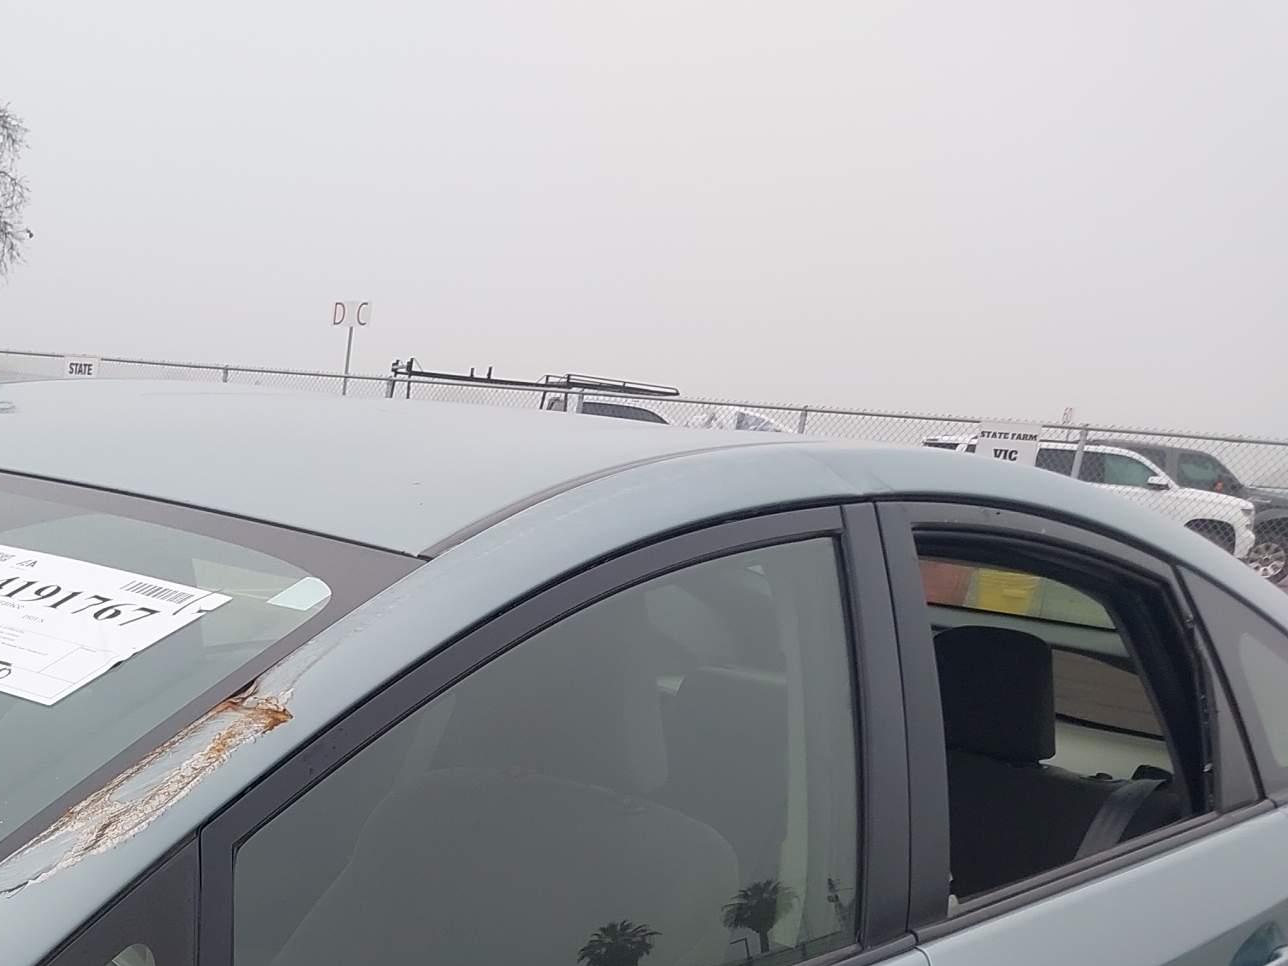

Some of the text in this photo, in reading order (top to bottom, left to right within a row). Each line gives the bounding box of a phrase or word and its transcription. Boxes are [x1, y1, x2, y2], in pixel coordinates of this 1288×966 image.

[333, 302, 369, 326] D C
[68, 362, 93, 376] STATE
[980, 430, 1038, 441] STATE FARM
[993, 448, 1018, 462] VIC
